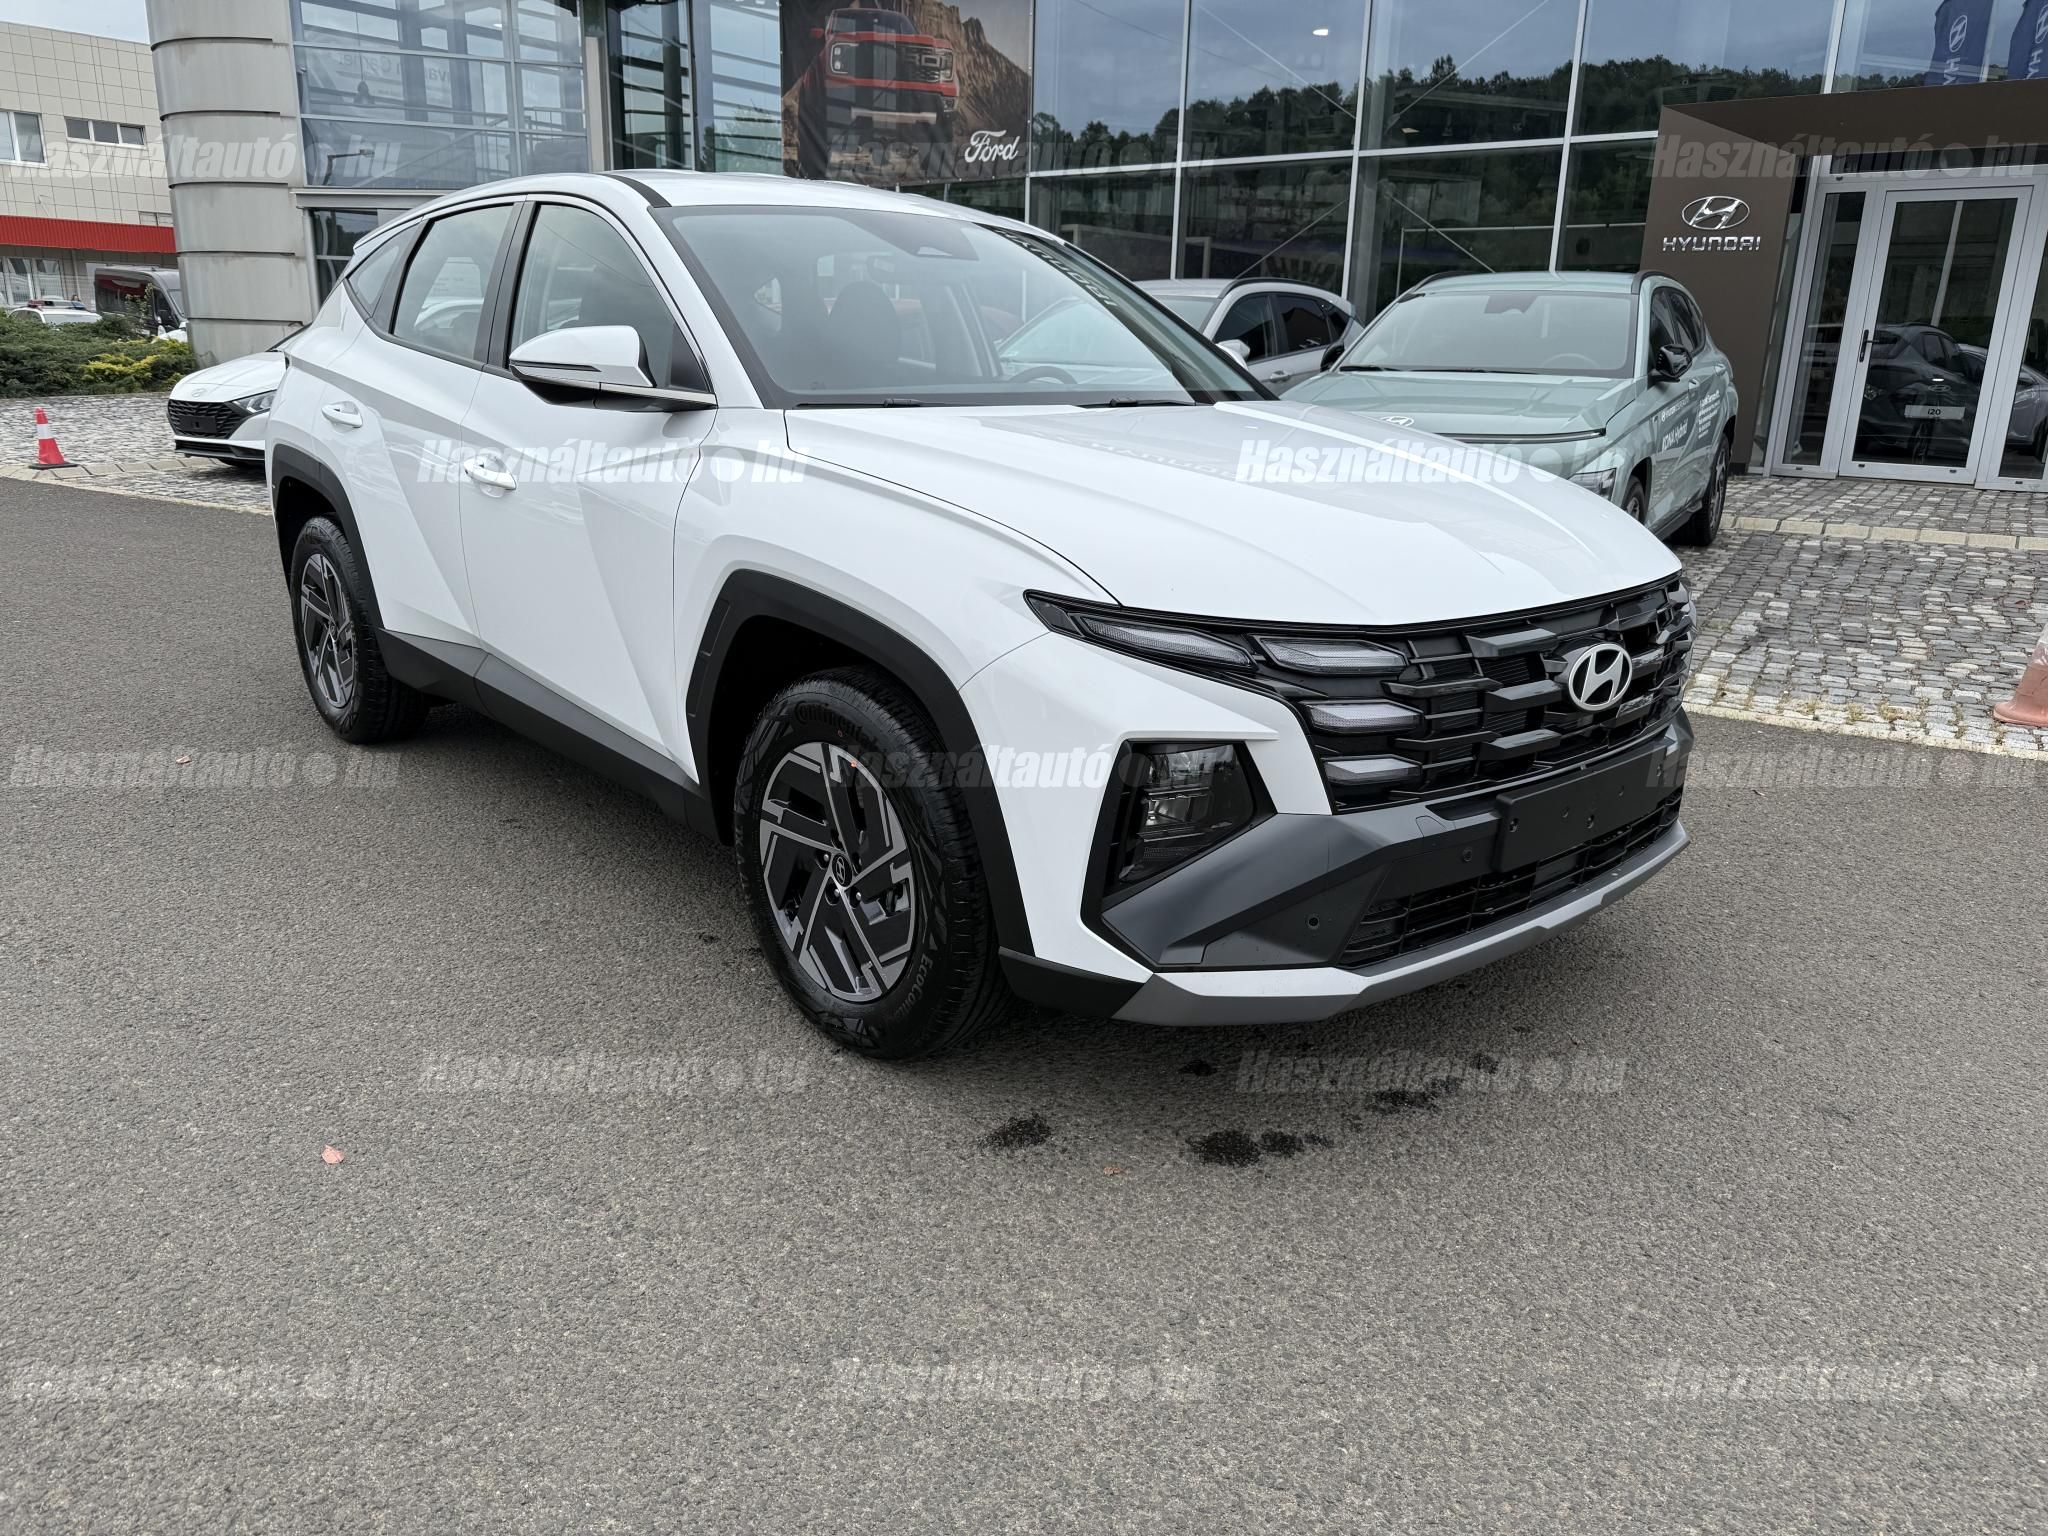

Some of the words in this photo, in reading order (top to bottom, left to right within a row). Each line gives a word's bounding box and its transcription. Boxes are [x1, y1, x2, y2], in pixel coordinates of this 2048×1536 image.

[964, 129, 1021, 163] Ford
[1662, 236, 1761, 251] HYUNDAI
[1927, 408, 1941, 416] i20
